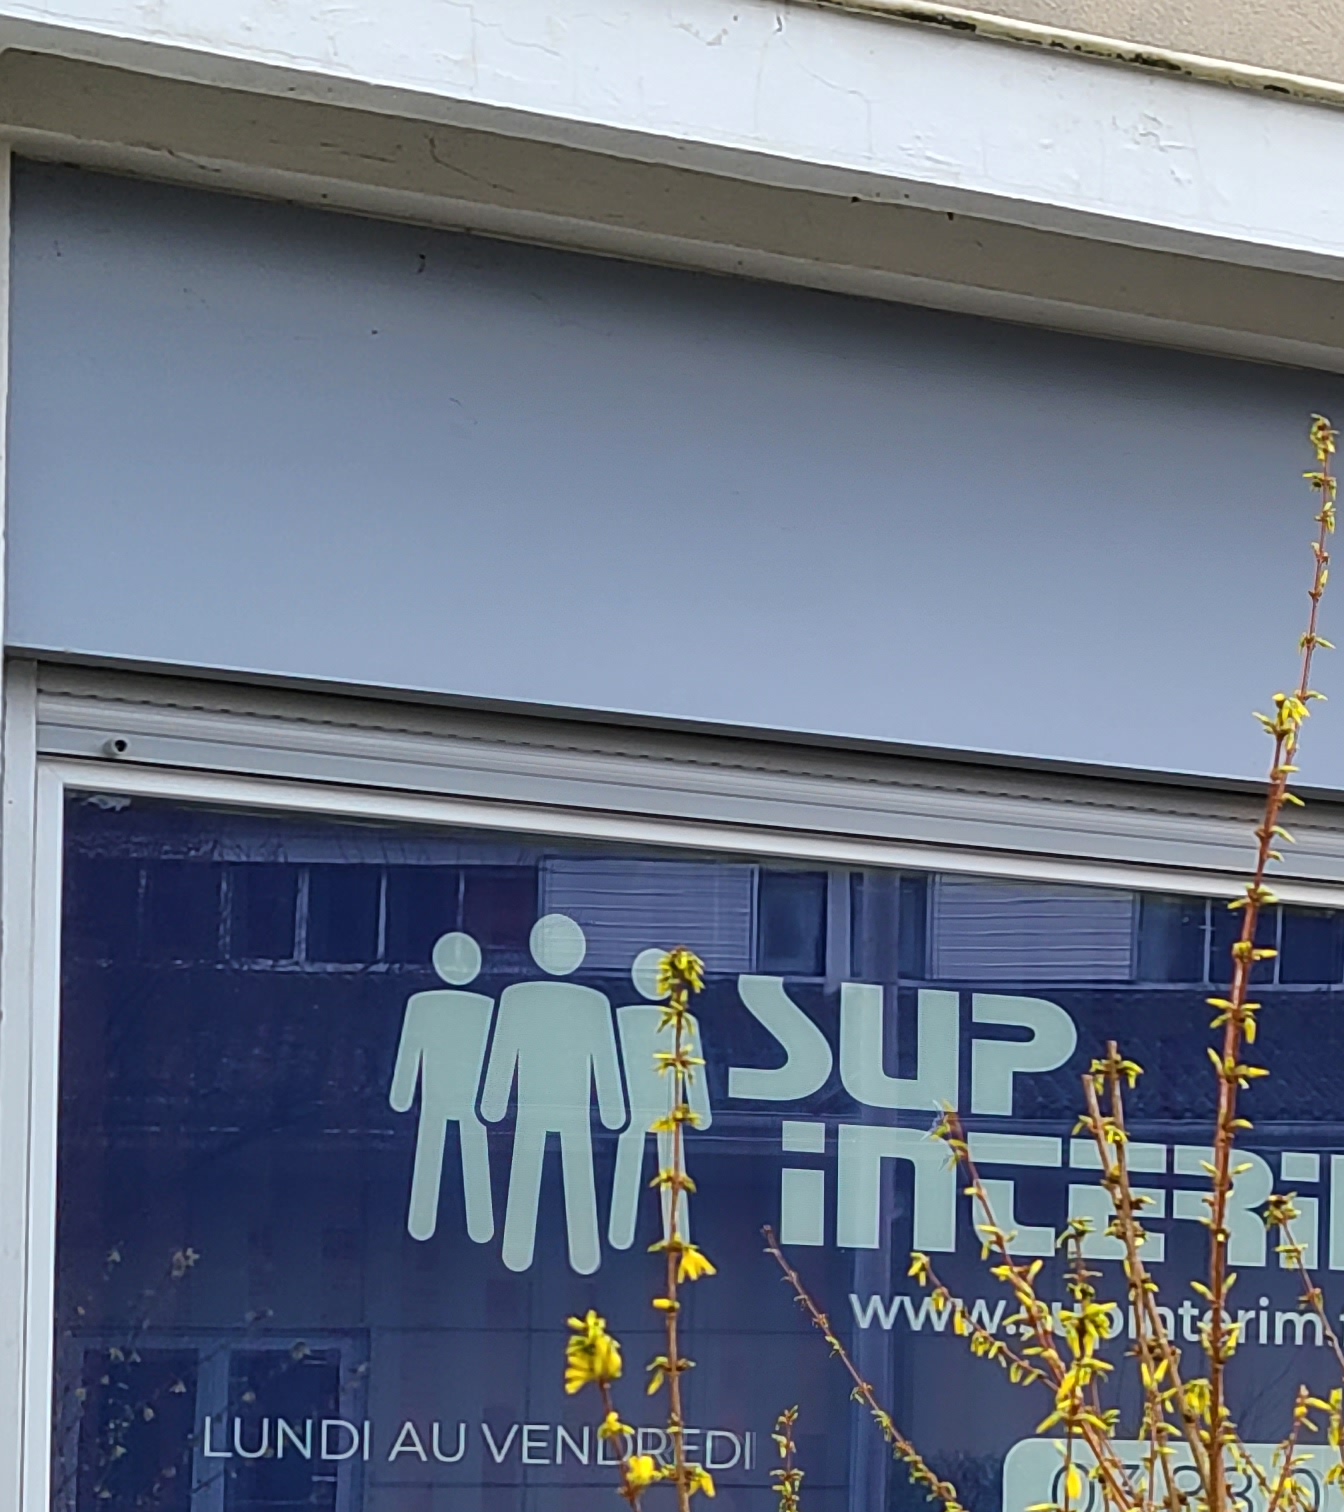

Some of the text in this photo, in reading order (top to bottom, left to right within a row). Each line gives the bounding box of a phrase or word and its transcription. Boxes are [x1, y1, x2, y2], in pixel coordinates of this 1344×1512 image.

[727, 975, 1078, 1116] SUP
[202, 1416, 752, 1471] LUNDI AU VENDREDI
